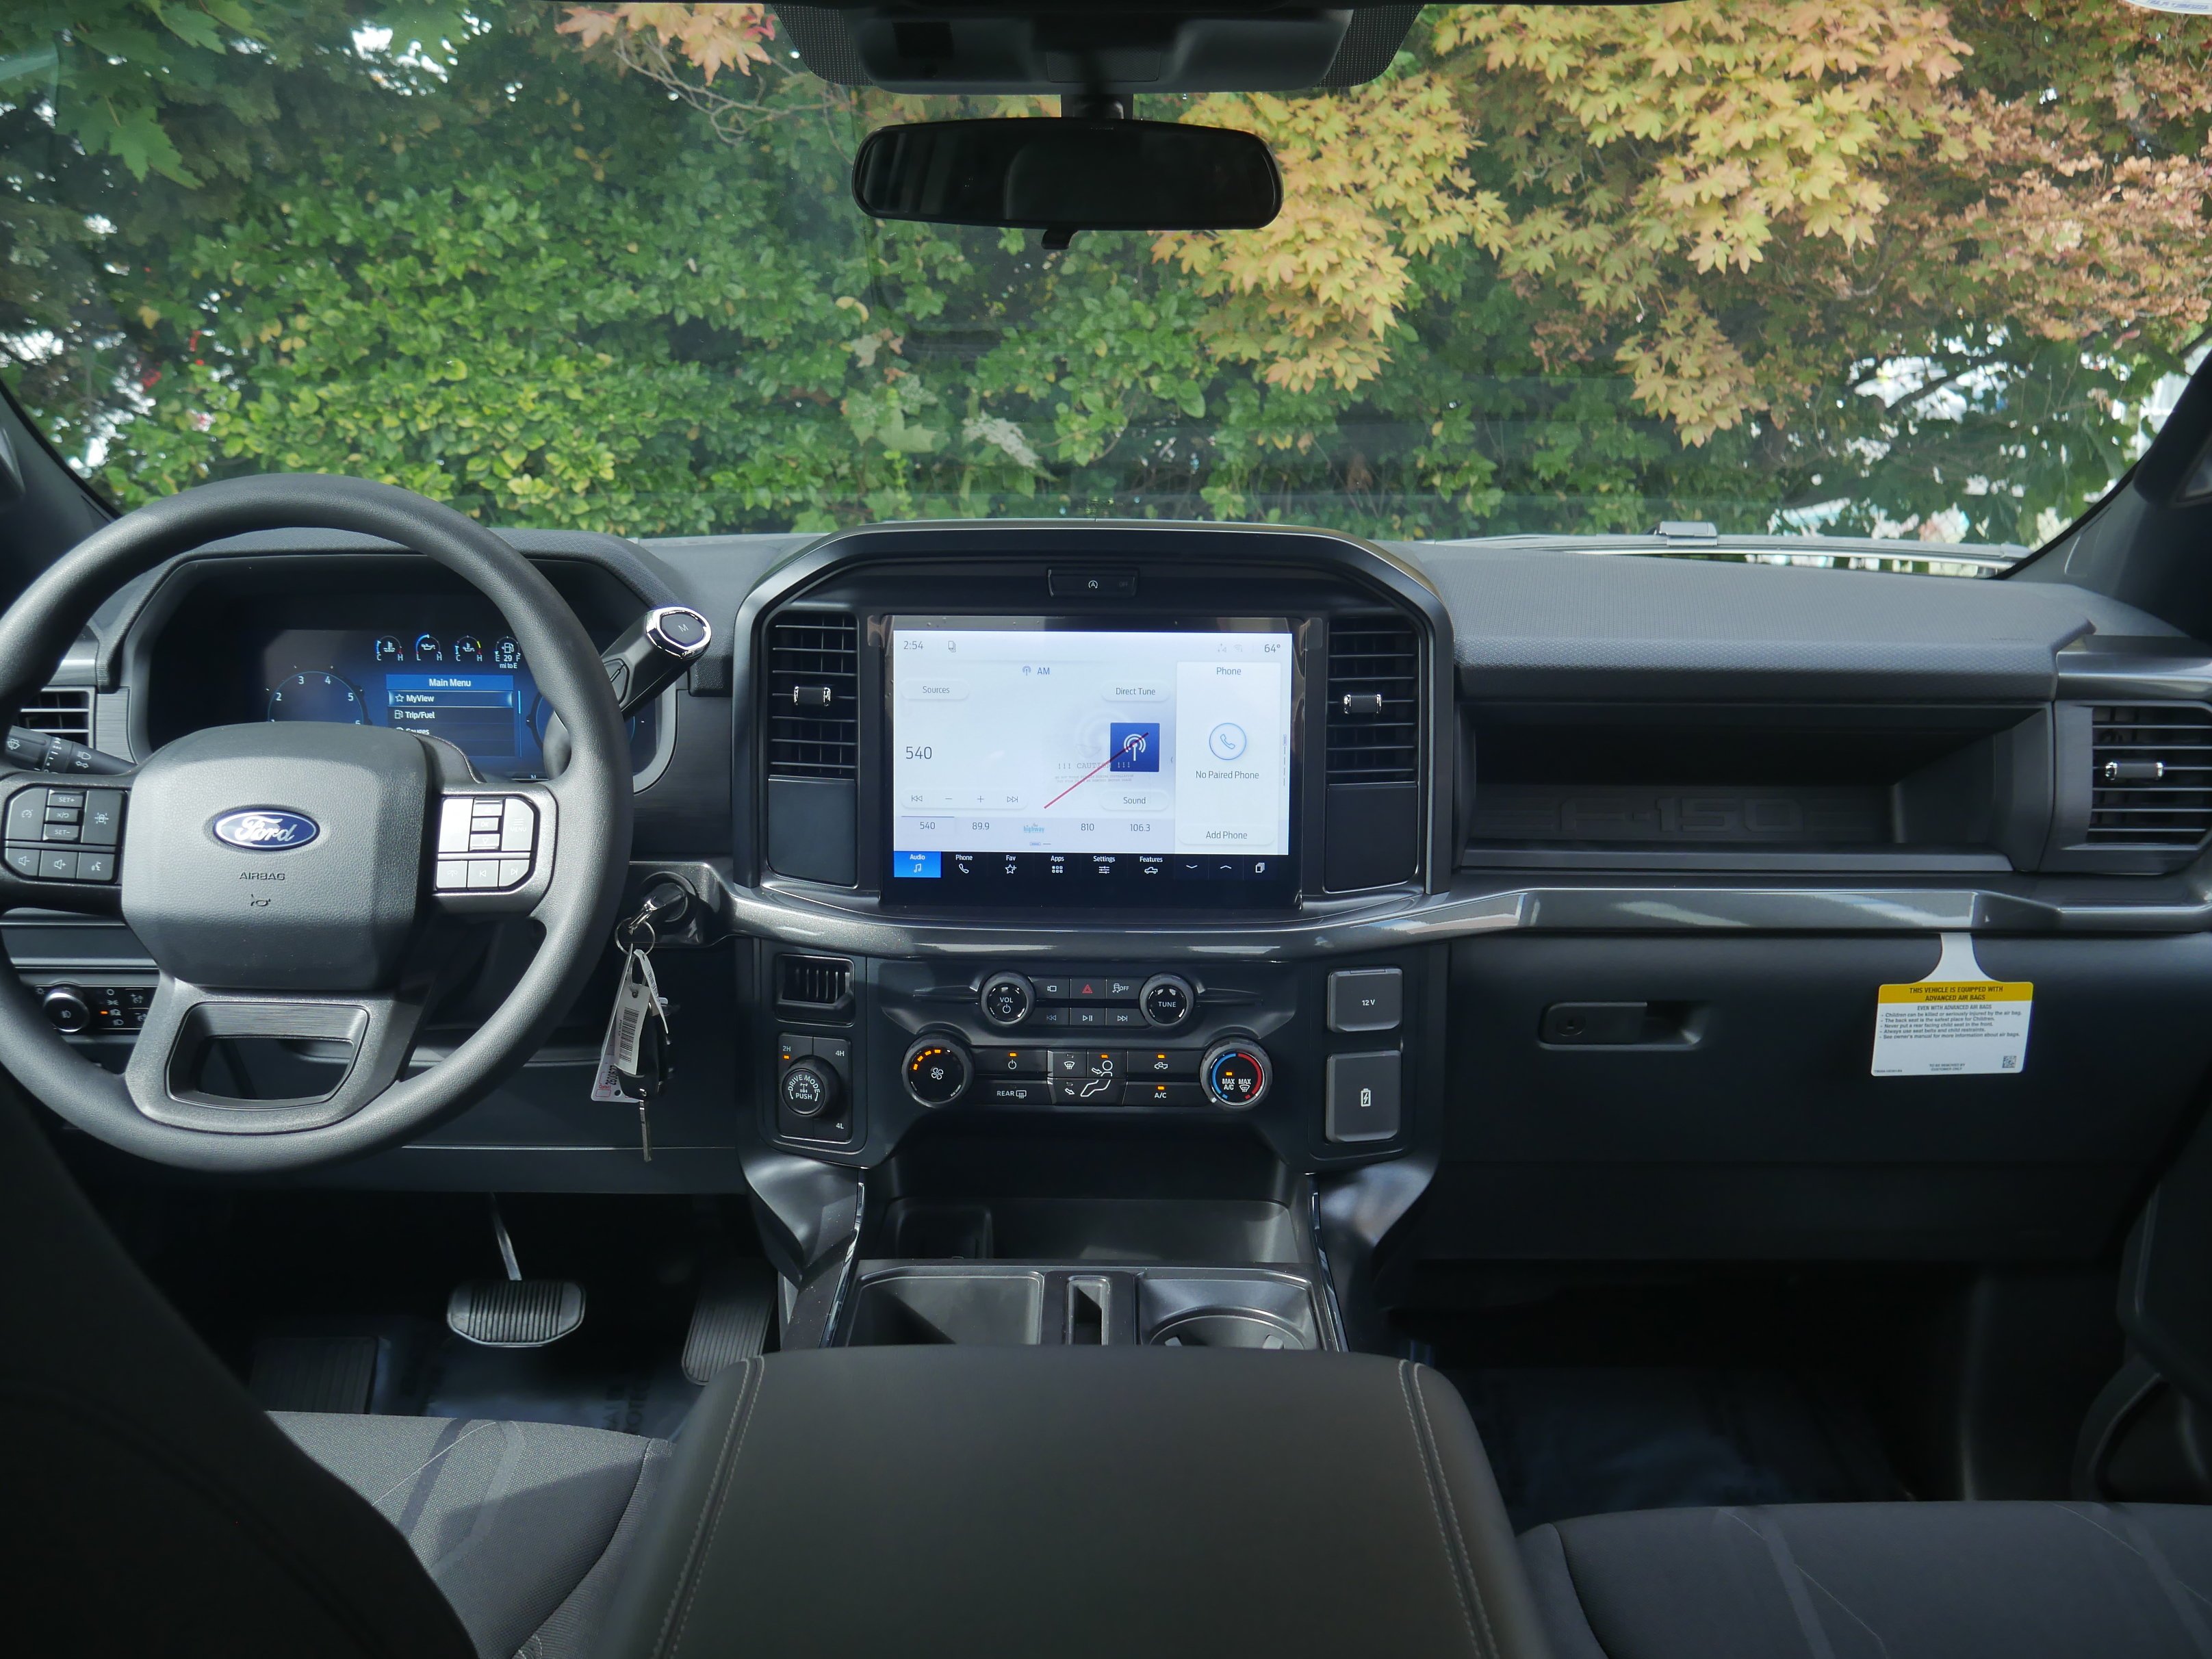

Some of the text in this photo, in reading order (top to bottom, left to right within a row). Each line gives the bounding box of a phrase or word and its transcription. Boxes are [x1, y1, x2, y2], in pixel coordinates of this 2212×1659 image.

[678, 623, 689, 632] M
[903, 641, 924, 650] 2:54
[1264, 644, 1281, 653] 64°
[298, 676, 305, 684] 3
[324, 676, 331, 684] 4
[923, 686, 950, 694] Sources
[1116, 687, 1156, 695] Direct Tune
[276, 693, 282, 701] 2
[348, 693, 354, 701] 5
[406, 695, 435, 703] MyView
[405, 711, 435, 719] Trip/Fuel
[905, 746, 932, 760] 540
[1196, 771, 1259, 779] No Paired Phone
[234, 815, 298, 842] Ford
[972, 822, 990, 830] 89.9
[1206, 831, 1248, 839] Add Phone
[240, 872, 285, 881] AIRBAG
[788, 1075, 820, 1093] DRIVE MODE
